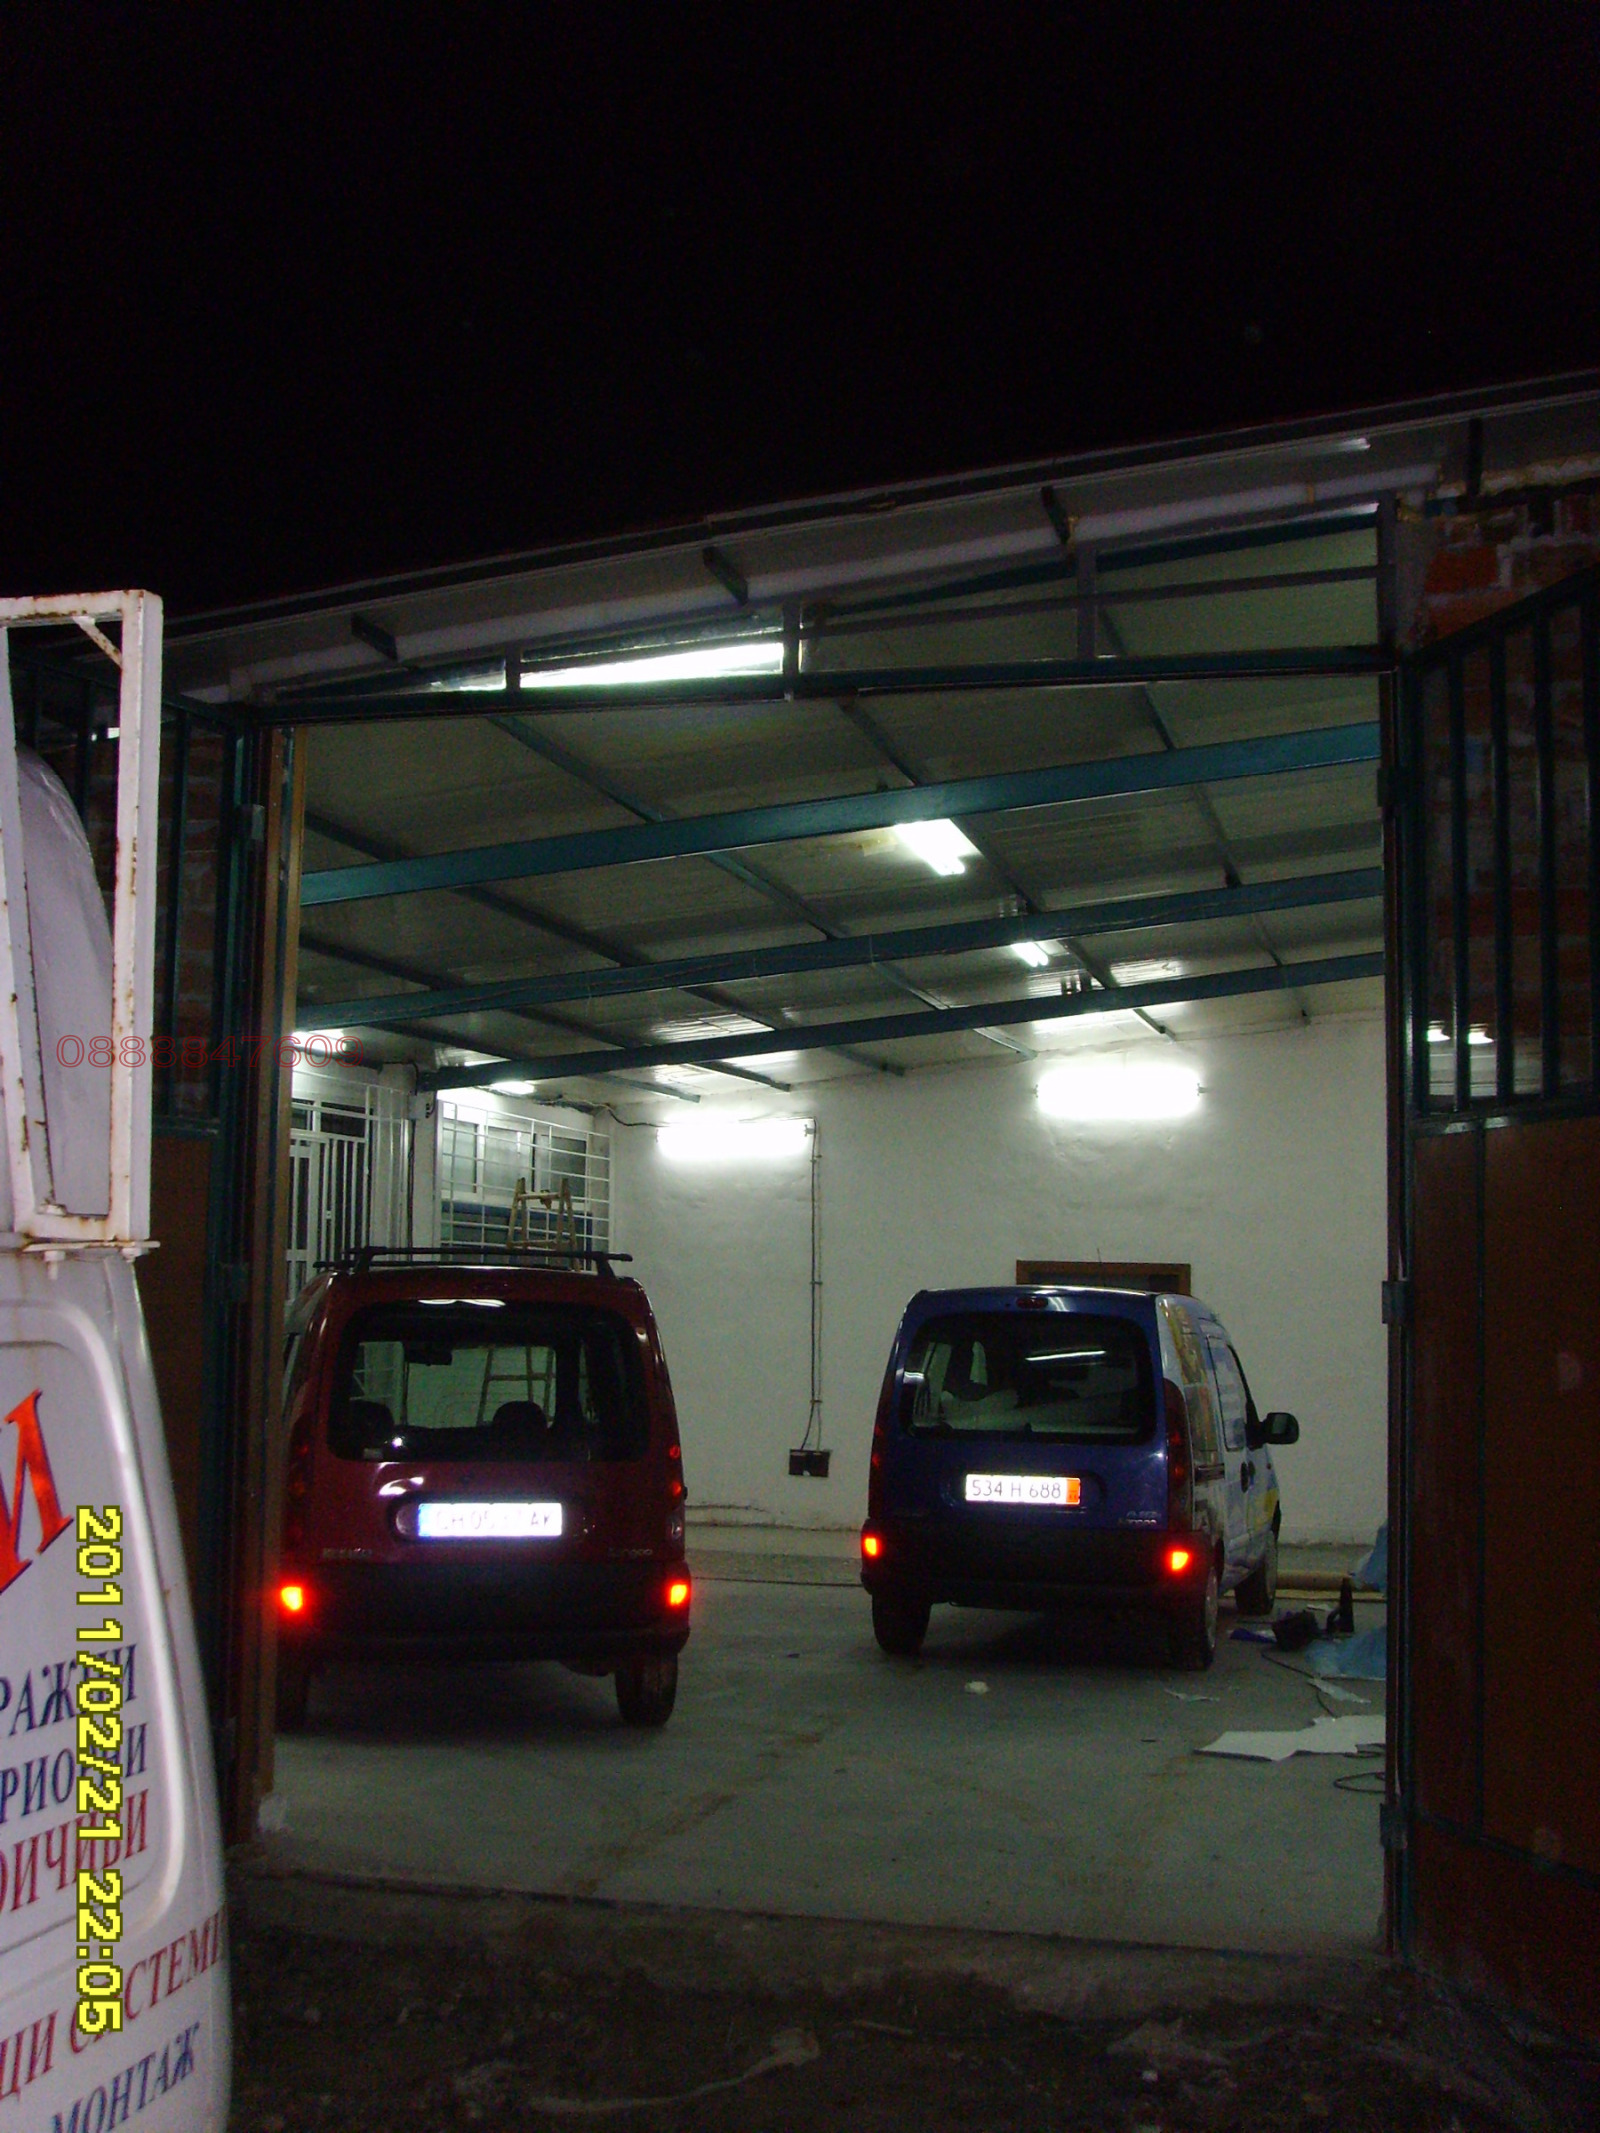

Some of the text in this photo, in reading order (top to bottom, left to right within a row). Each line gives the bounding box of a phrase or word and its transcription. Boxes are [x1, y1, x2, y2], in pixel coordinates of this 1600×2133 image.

[971, 1479, 1003, 1497] 534
[1010, 1482, 1022, 1498] H
[1029, 1482, 1061, 1499] 688
